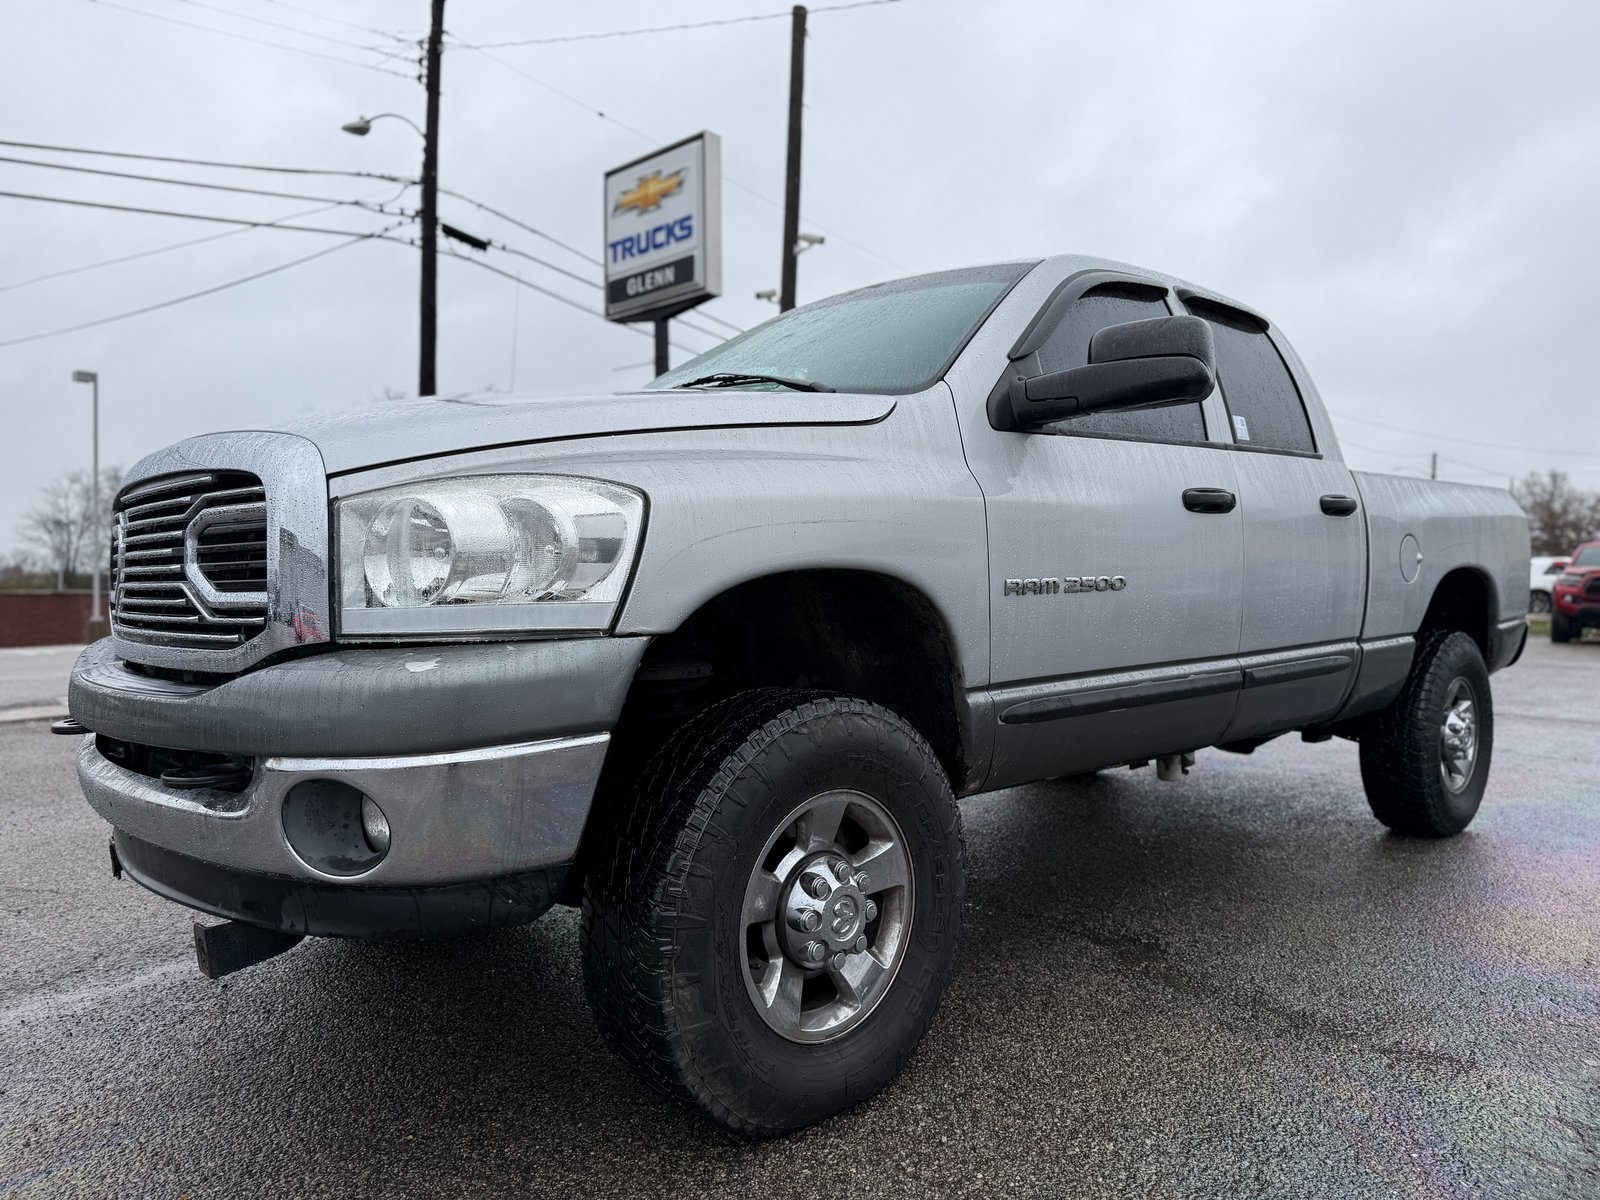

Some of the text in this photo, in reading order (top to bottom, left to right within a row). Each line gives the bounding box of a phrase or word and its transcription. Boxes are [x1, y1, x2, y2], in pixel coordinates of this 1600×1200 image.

[608, 214, 694, 264] TRUCKS
[626, 265, 676, 296] GLENN
[1004, 575, 1128, 596] RAM 2500
